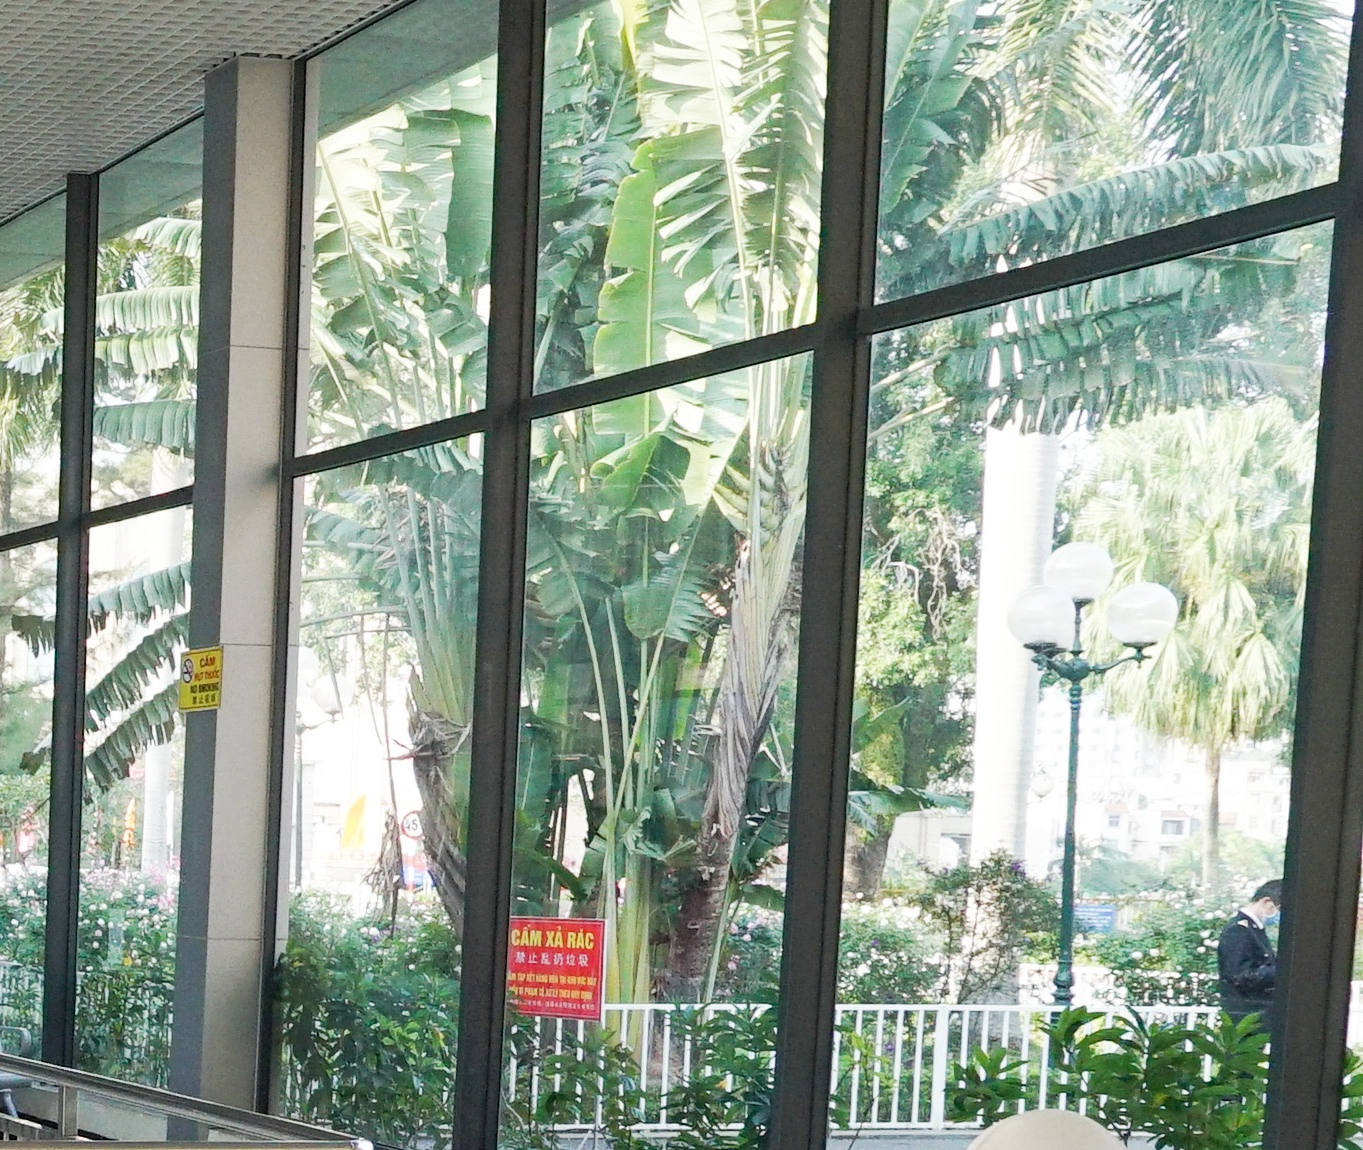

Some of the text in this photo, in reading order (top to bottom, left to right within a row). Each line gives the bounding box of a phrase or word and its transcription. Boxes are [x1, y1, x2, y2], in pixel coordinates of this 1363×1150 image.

[404, 819, 418, 831] 45
[511, 924, 594, 949] CẤM XẢ RÁC
